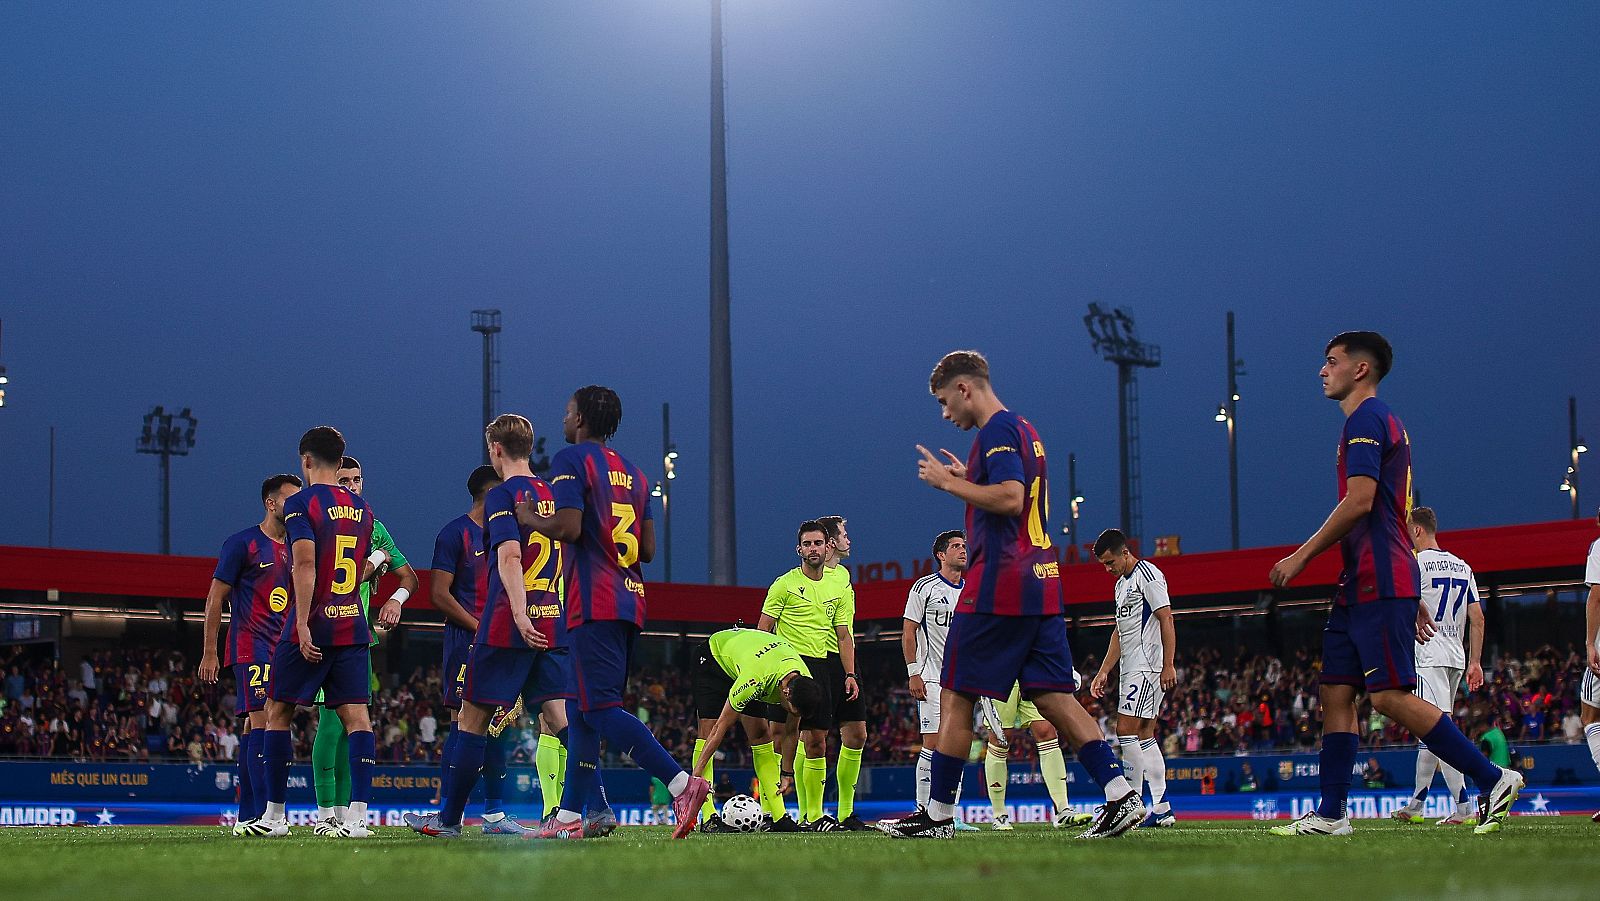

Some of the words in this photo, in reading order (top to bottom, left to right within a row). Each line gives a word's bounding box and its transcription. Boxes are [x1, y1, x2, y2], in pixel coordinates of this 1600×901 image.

[611, 503, 638, 568] 3
[330, 535, 358, 595] 5
[1432, 577, 1468, 622] 77
[1126, 684, 1138, 701] 2
[51, 770, 75, 785] MÉS
[77, 773, 100, 787] QUE
[102, 773, 118, 785] UN
[120, 773, 148, 785] CLUB
[394, 776, 414, 789] QUE
[415, 777, 430, 788] UN
[1347, 797, 1379, 819] STA
